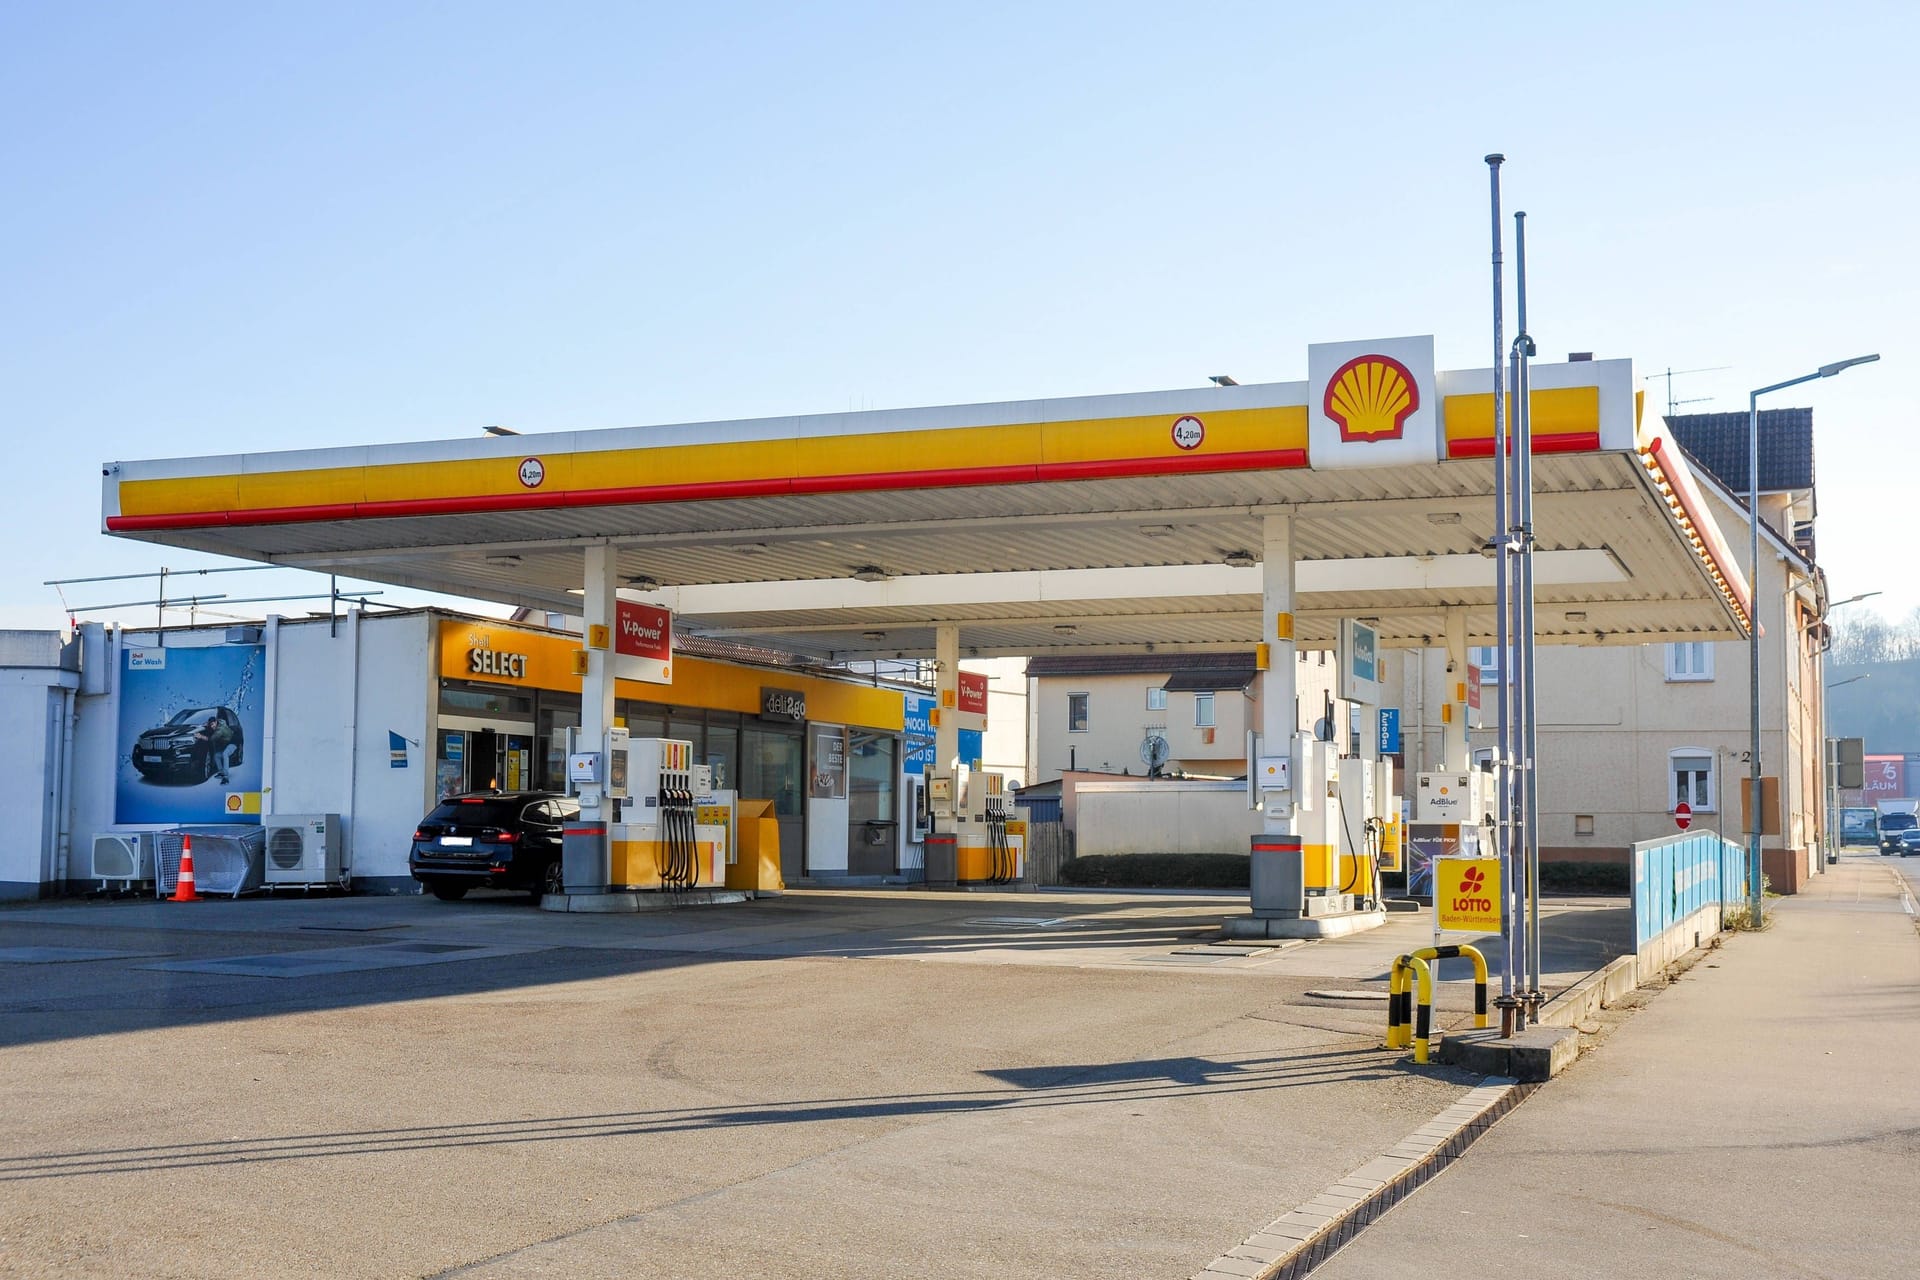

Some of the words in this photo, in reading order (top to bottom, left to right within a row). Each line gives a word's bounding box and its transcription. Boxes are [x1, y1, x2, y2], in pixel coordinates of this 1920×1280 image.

[1176, 427, 1200, 440] 4,20m
[623, 620, 661, 640] V-Power
[469, 632, 489, 648] Shell
[472, 648, 527, 677] SELECT
[768, 694, 805, 720] deli2go
[1381, 711, 1389, 749] AutoGas
[1881, 762, 1896, 779] 75
[1866, 780, 1896, 790] LÄUM
[1453, 898, 1491, 912] LOTTO
[1442, 914, 1501, 924] Baden-Württember
